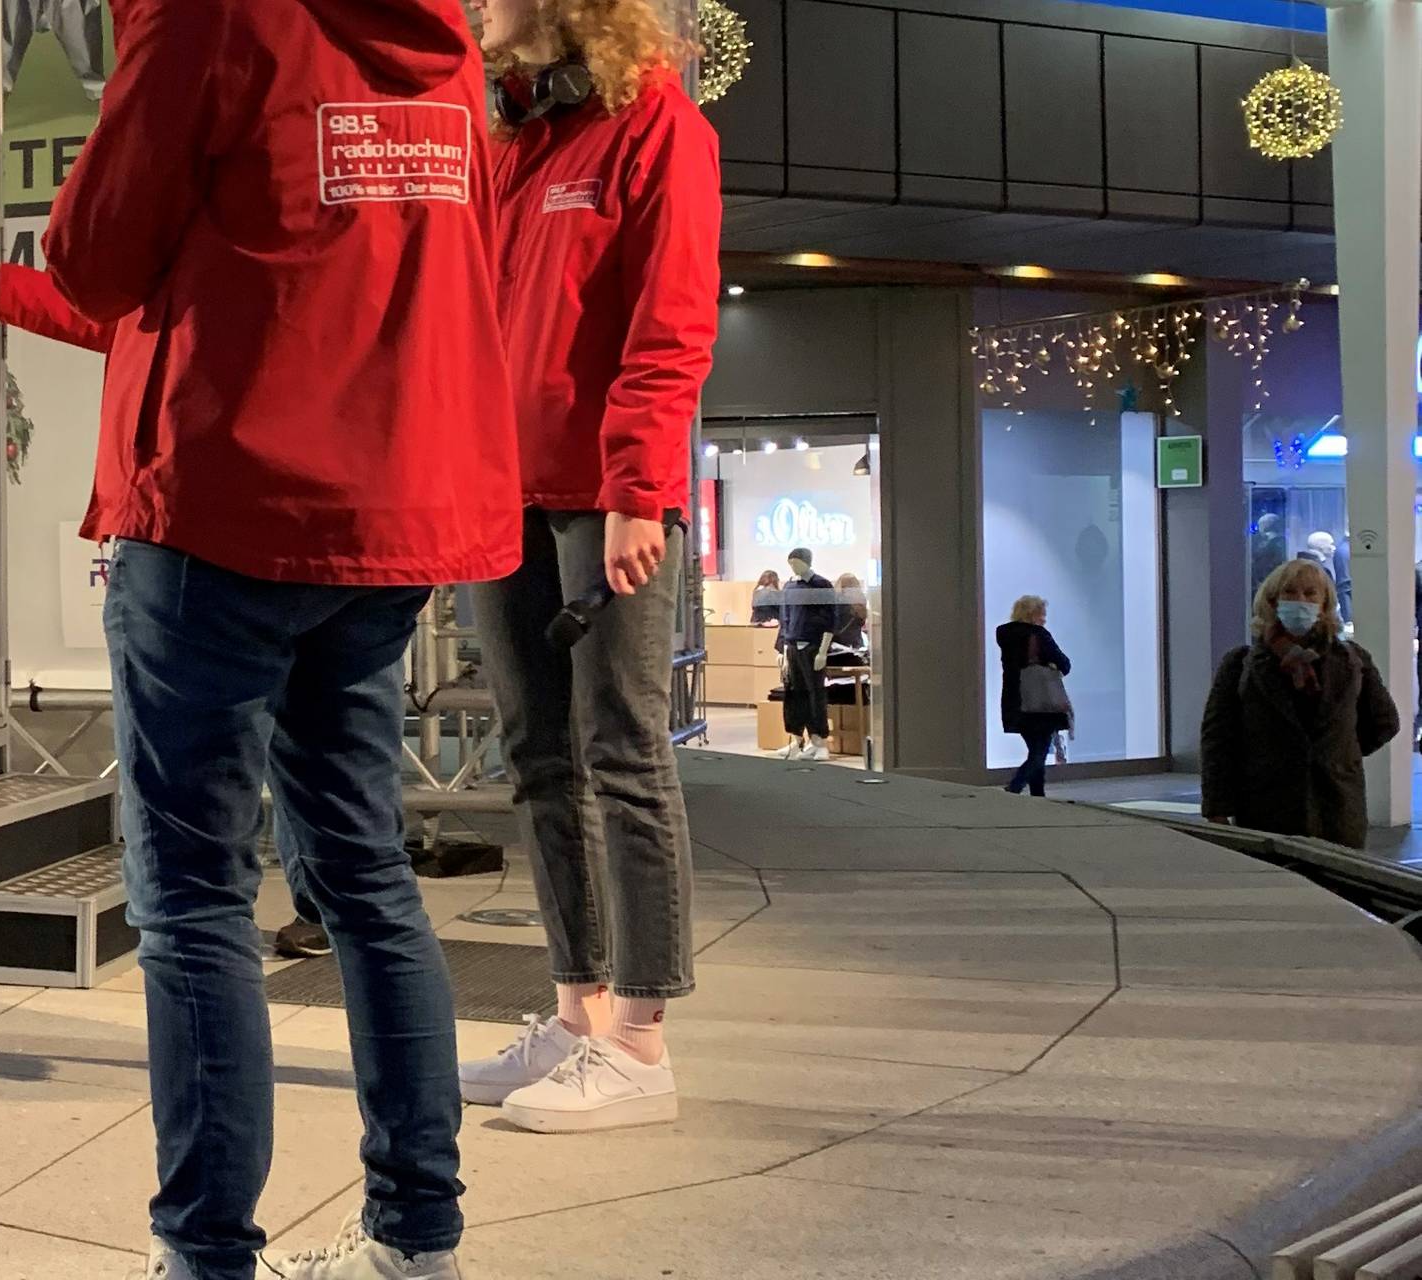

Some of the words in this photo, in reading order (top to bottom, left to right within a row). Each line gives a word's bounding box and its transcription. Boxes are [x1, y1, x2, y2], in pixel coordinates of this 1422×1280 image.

[330, 115, 379, 135] 98.5
[332, 138, 384, 160] radio
[386, 138, 462, 160] bochum
